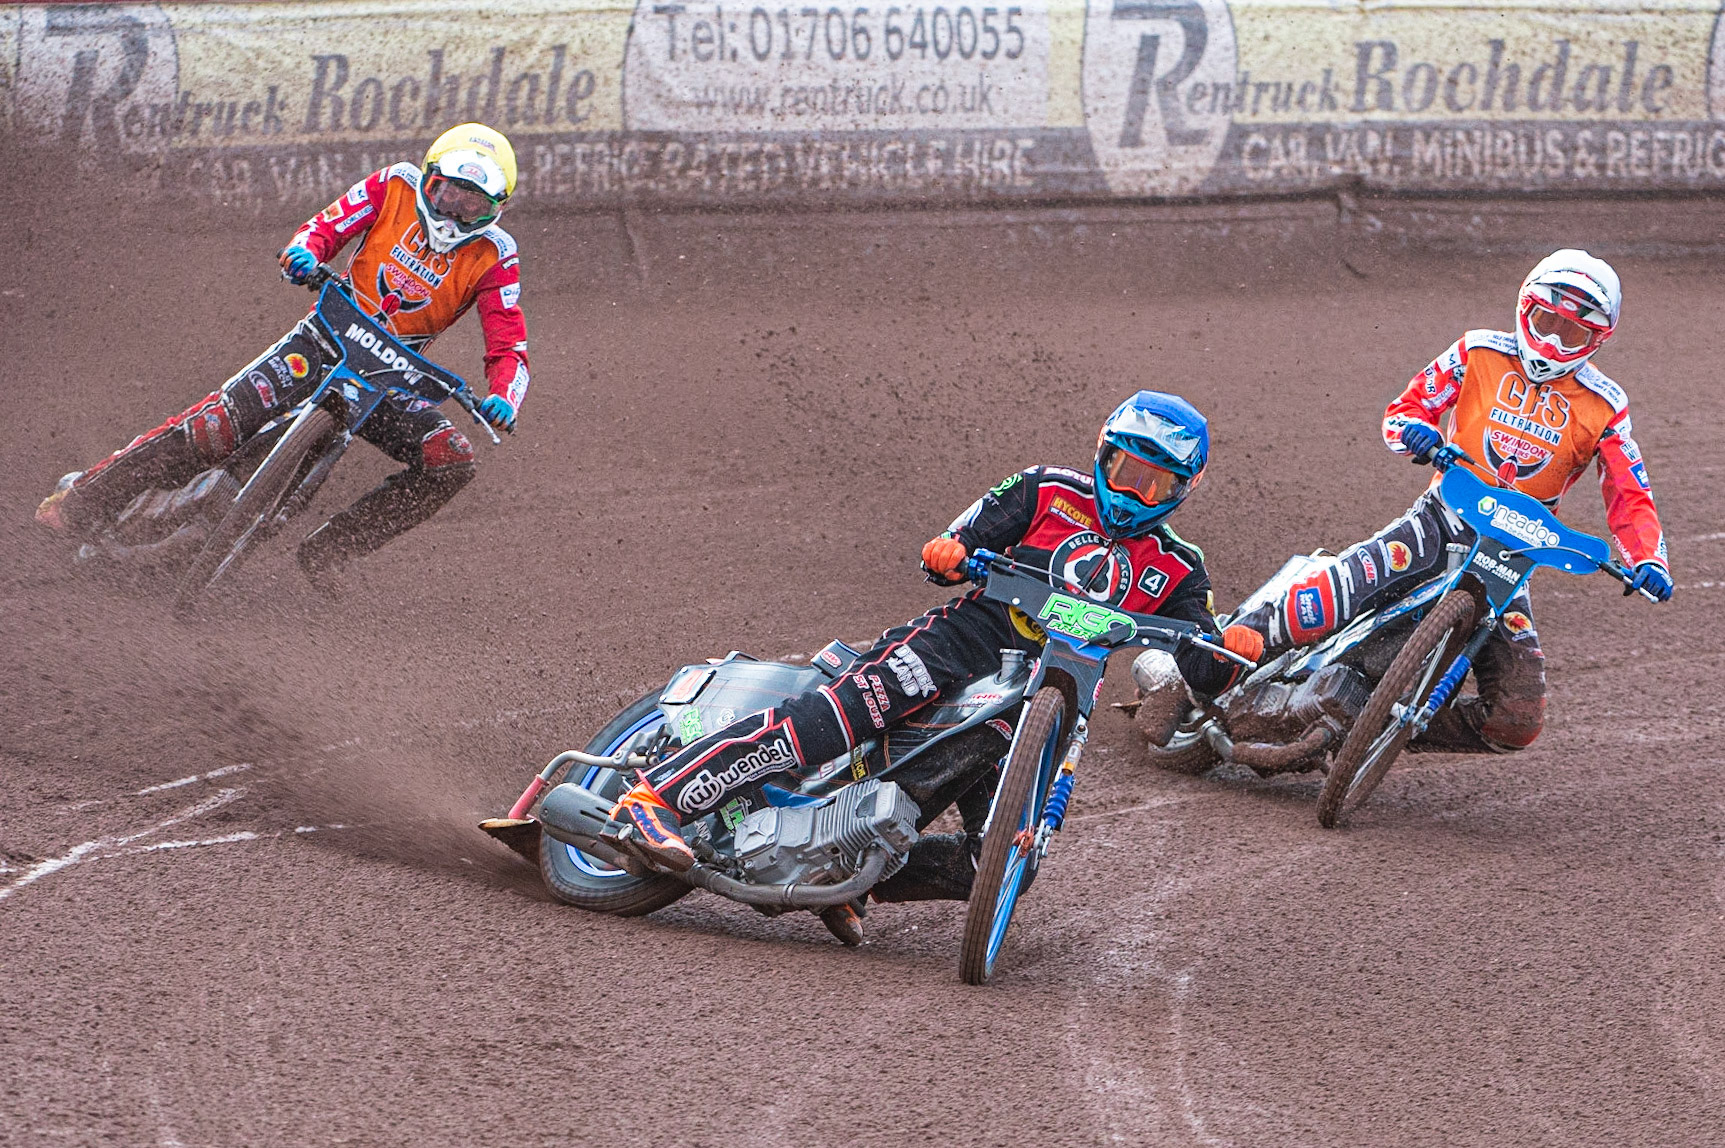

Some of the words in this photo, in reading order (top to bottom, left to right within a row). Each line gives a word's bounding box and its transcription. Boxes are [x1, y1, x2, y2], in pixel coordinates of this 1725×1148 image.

[654, 6, 738, 61] Tel:
[748, 6, 872, 61] 01706
[884, 6, 1026, 61] 640055
[304, 44, 597, 131] Rochdale
[691, 72, 995, 115] www.rentruck.co.uk
[1347, 39, 1676, 113] Rochdale
[954, 138, 1036, 187] HIRE
[1413, 128, 1560, 178] MINIBUS
[1574, 129, 1599, 178] &
[385, 263, 430, 297] SWINDON
[390, 245, 443, 289] FILTRATION
[1496, 370, 1570, 430] CFS
[1489, 408, 1561, 445] FILTRATION
[1491, 431, 1548, 459] SWINDON
[1053, 496, 1092, 527] HYCOTE
[1067, 534, 1100, 550] BELLE
[1119, 563, 1128, 591] ACES
[1144, 573, 1162, 592] 4
[868, 674, 891, 712] PIZZA
[885, 656, 920, 697] LAND
[853, 674, 870, 690] ST
[862, 691, 885, 728] LOUIS
[718, 738, 792, 786] wendel
